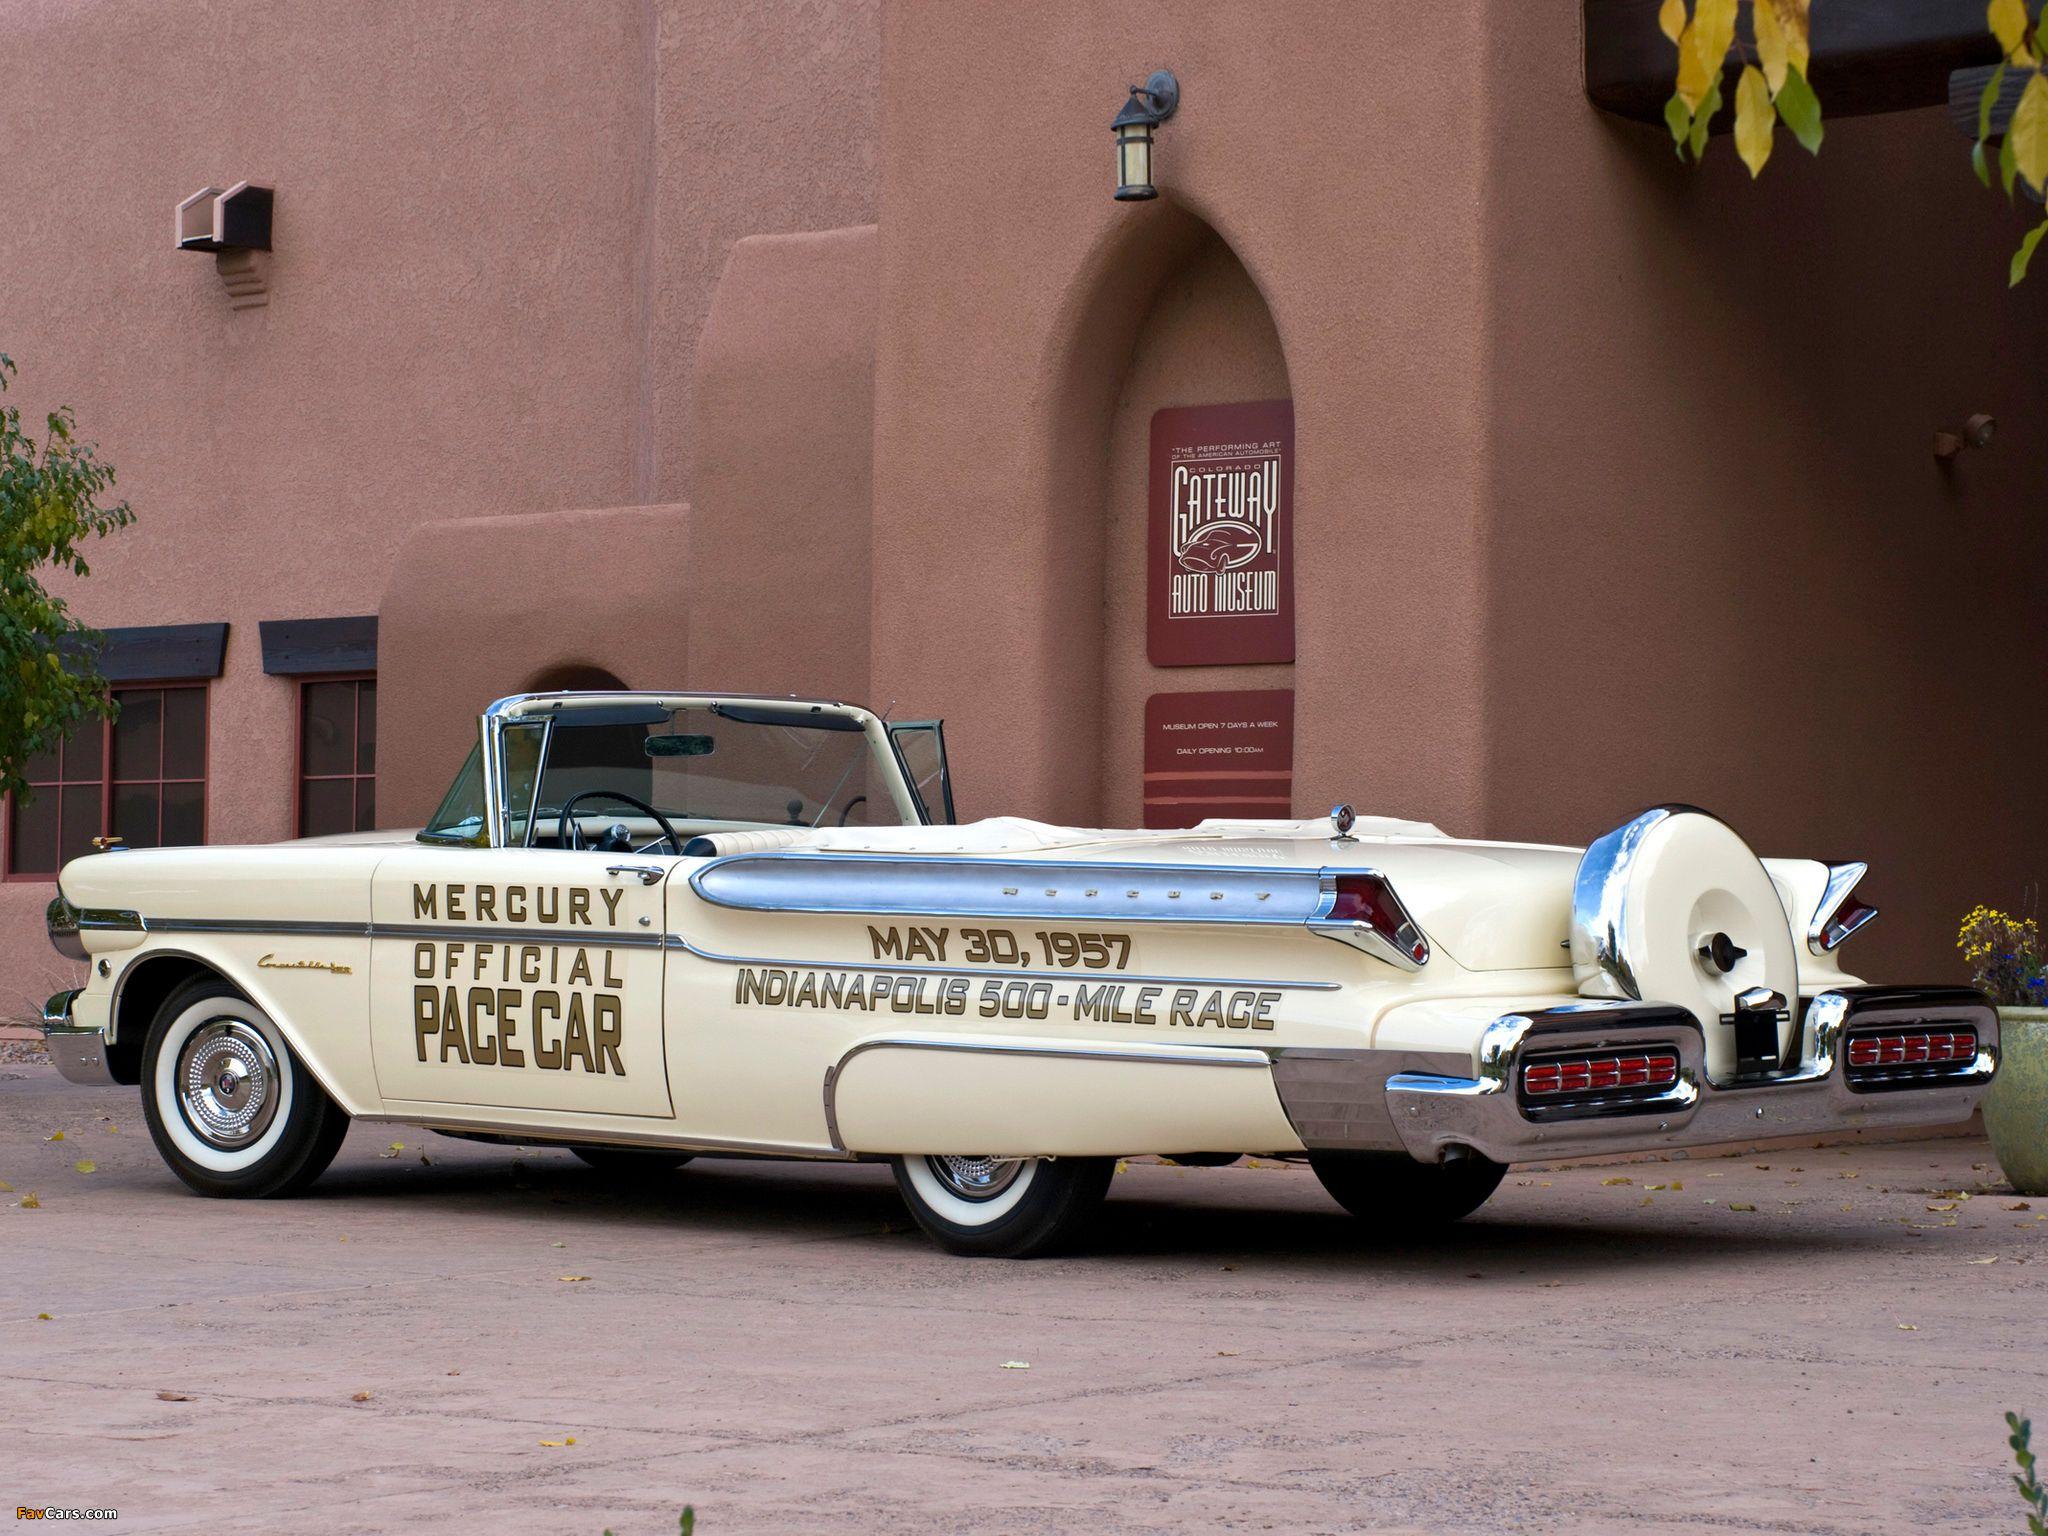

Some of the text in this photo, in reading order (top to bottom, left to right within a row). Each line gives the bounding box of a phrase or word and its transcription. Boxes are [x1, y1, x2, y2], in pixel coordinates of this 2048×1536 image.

[1189, 463, 1261, 473] COLORADO
[1197, 442, 1258, 453] PERFORMING
[1173, 460, 1278, 557] GATEWAY
[1172, 570, 1276, 614] AUTO MUSEUM
[1163, 723, 1196, 731] MUSEUM
[1198, 722, 1219, 730] OPEN
[1227, 721, 1248, 729] DAYS
[1257, 720, 1279, 728] WEEK
[1177, 747, 1197, 755] DAILY
[1199, 747, 1231, 755] OPENING
[413, 883, 624, 926] MERCURY
[867, 925, 949, 961] MAY
[414, 942, 623, 988] OFFICIAL
[735, 968, 970, 1015] INDIANAPOLIS
[1170, 988, 1282, 1031] RACE
[414, 985, 626, 1076] PACE CAR
